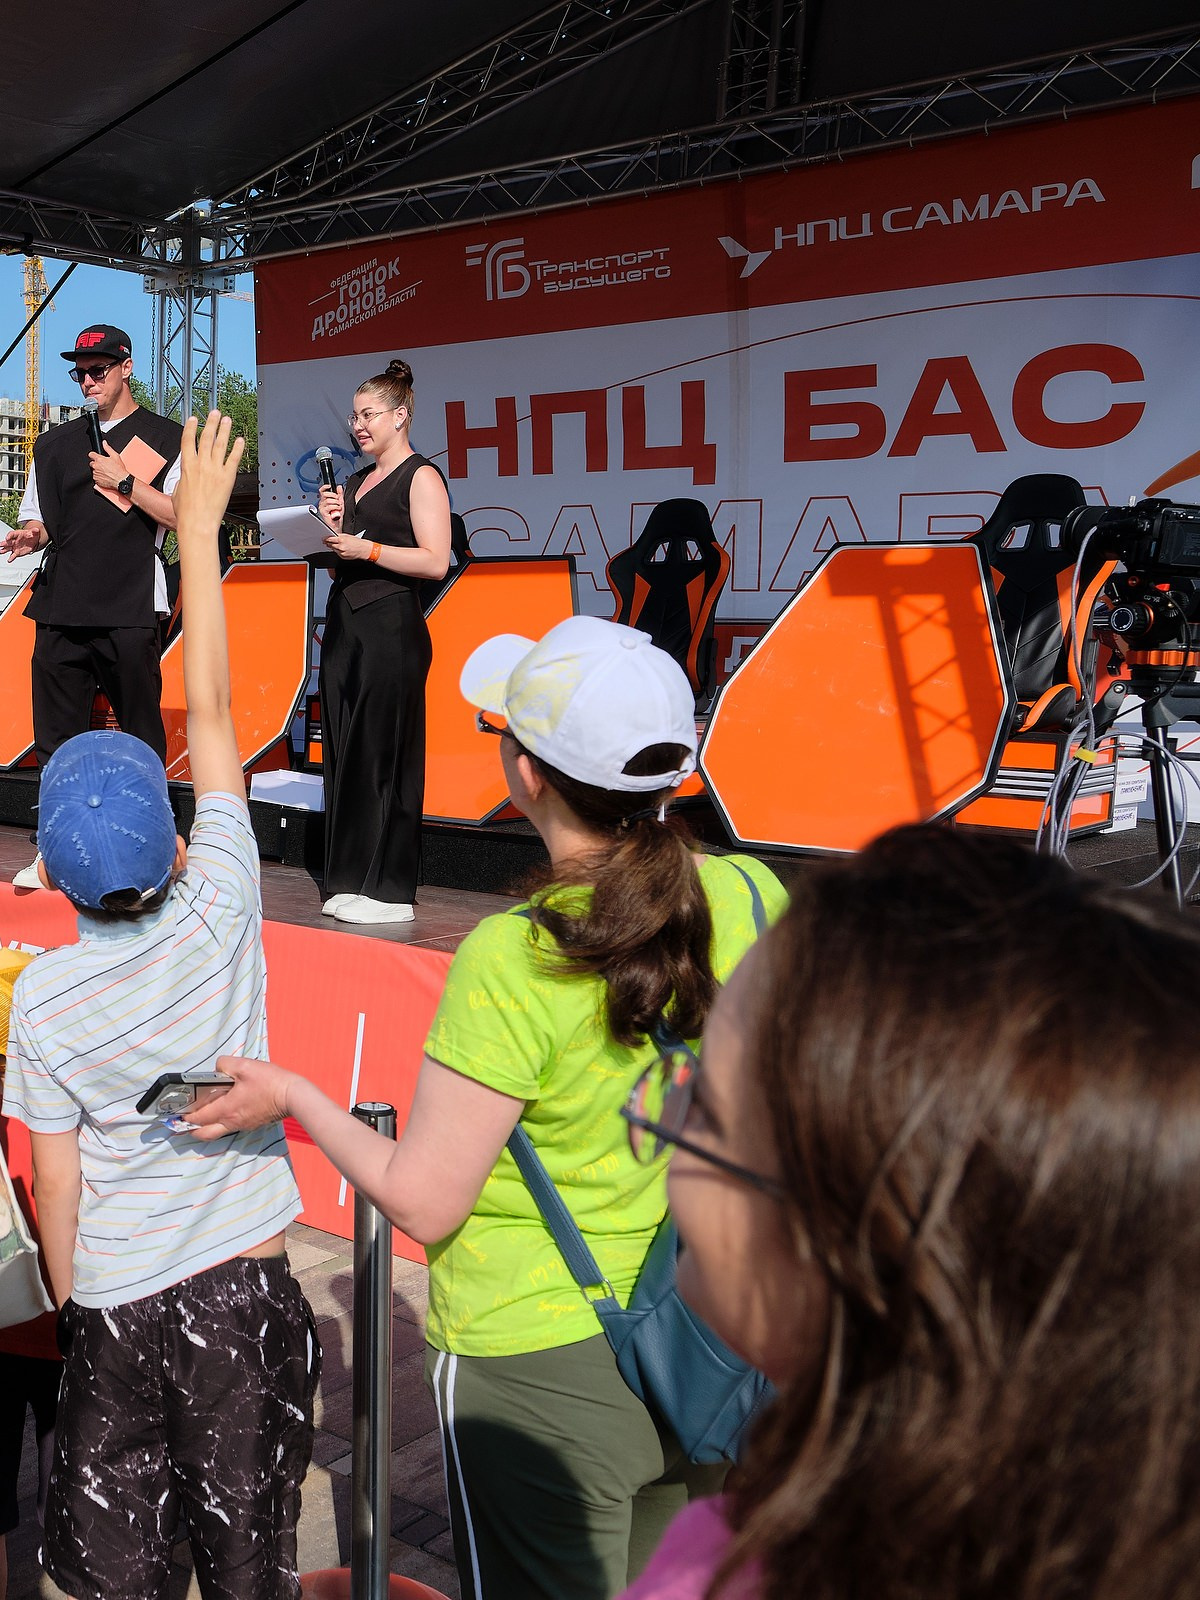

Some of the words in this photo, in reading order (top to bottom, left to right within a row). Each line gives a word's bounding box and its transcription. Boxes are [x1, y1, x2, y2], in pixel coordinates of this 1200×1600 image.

[774, 212, 874, 250] НПЦ
[882, 177, 1106, 233] САМАРА
[330, 257, 378, 289] ФЕДЕРАЦИЯ
[339, 256, 401, 305] ГОНОК
[311, 284, 388, 341] ДРОНОВ
[328, 306, 377, 337] САМАРСКОЙ
[378, 287, 417, 313] ОБЛАСТИ
[444, 378, 718, 486] НПЦ
[783, 342, 1147, 463] БАС
